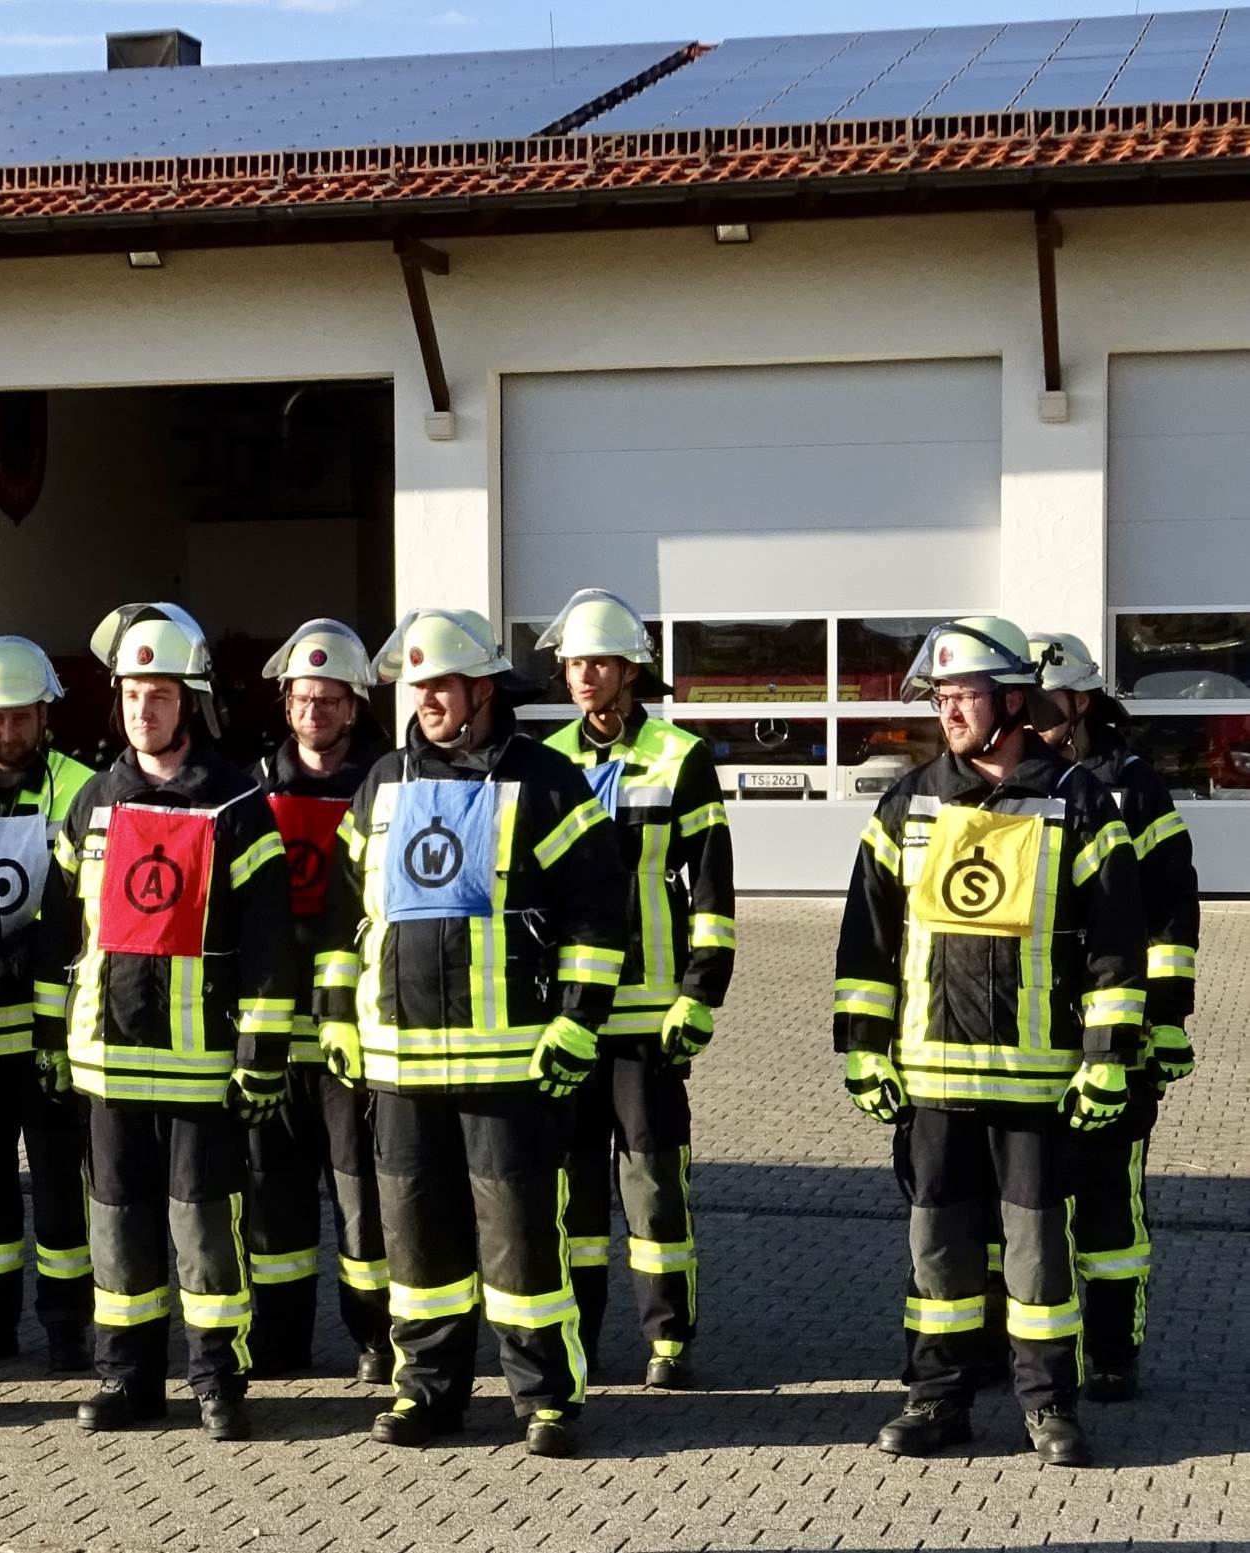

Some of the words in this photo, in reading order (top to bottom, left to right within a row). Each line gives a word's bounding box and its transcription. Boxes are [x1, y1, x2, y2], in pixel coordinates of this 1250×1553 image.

[751, 775, 765, 786] TS
[772, 774, 798, 786] 2621
[421, 842, 448, 875] W
[140, 865, 164, 899] A
[960, 870, 990, 907] S
